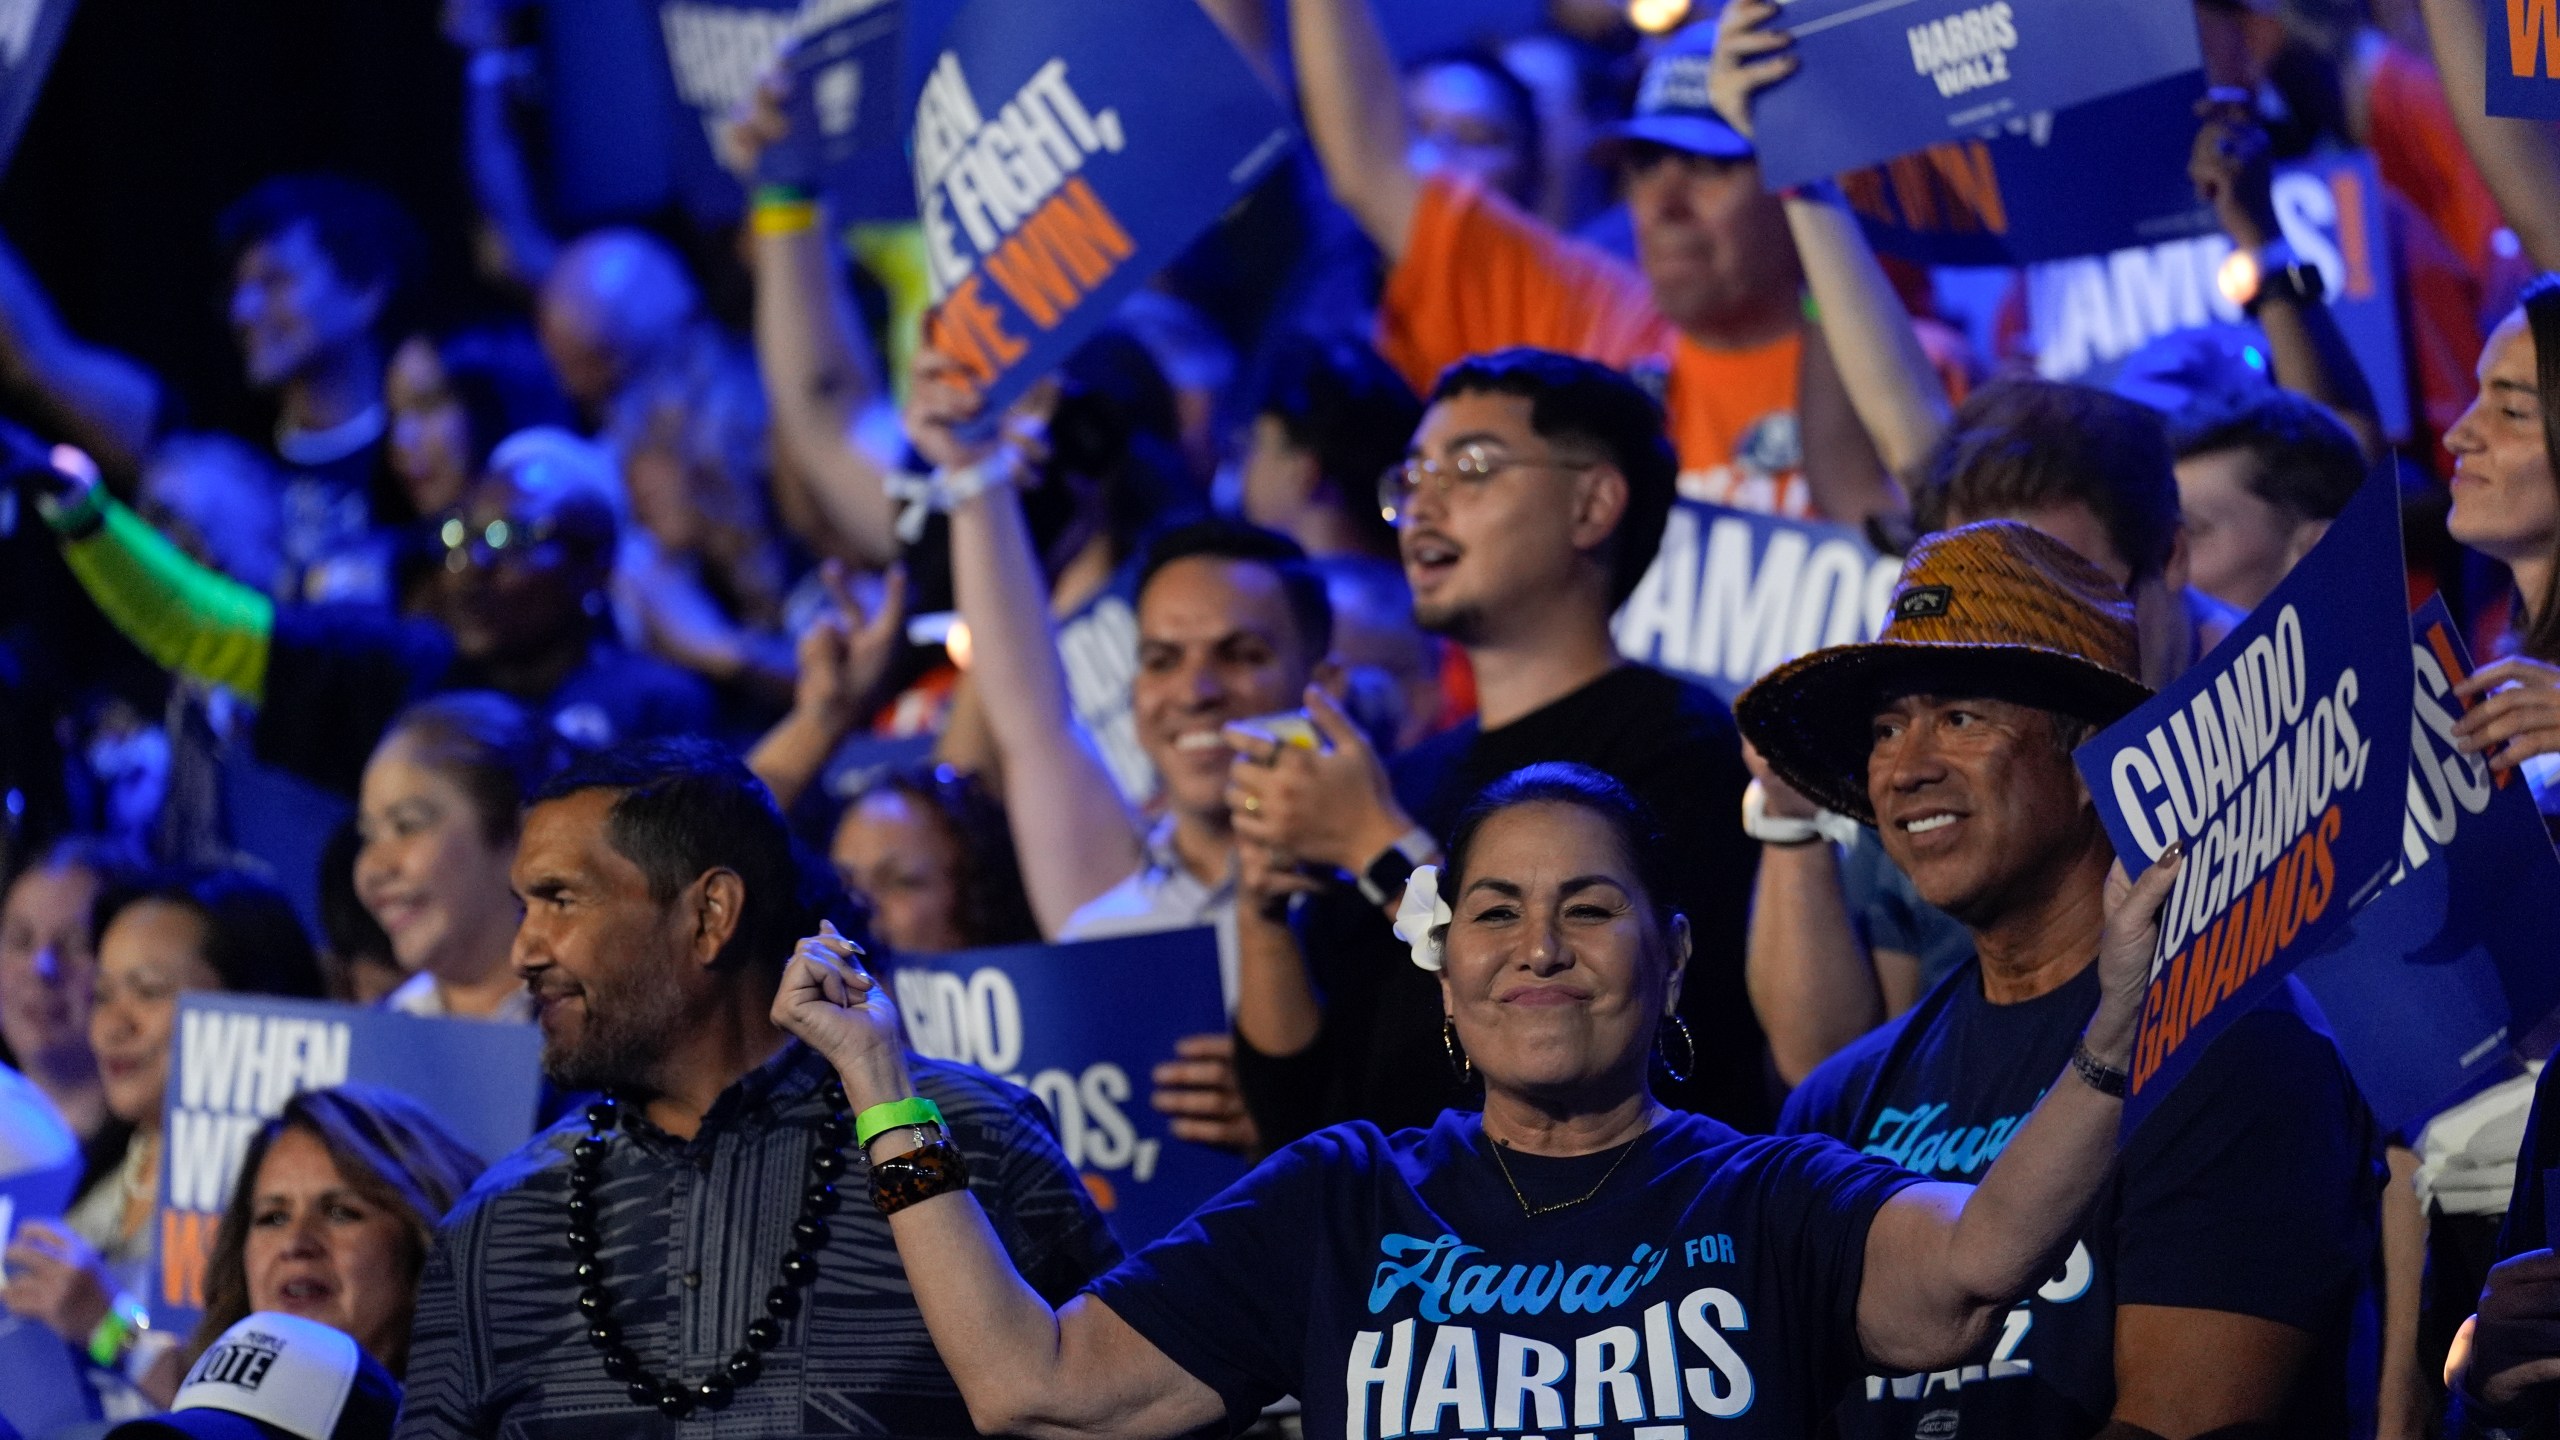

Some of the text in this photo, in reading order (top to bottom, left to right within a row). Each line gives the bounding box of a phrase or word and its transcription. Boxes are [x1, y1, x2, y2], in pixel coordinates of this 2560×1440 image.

[1906, 2, 2018, 76] HARRIS
[1932, 49, 2011, 98] WALZ
[945, 56, 1127, 256] FIGHT,
[983, 175, 1138, 331] WIN
[2112, 603, 2306, 864] CUANDO
[2390, 621, 2512, 886] OS!
[2132, 805, 2341, 1097] GANAMOS
[180, 1009, 350, 1117] WHEN
[1008, 1062, 1160, 1183] OS,
[1685, 1233, 1736, 1268] FOR
[1346, 1287, 1755, 1440] HARRIS
